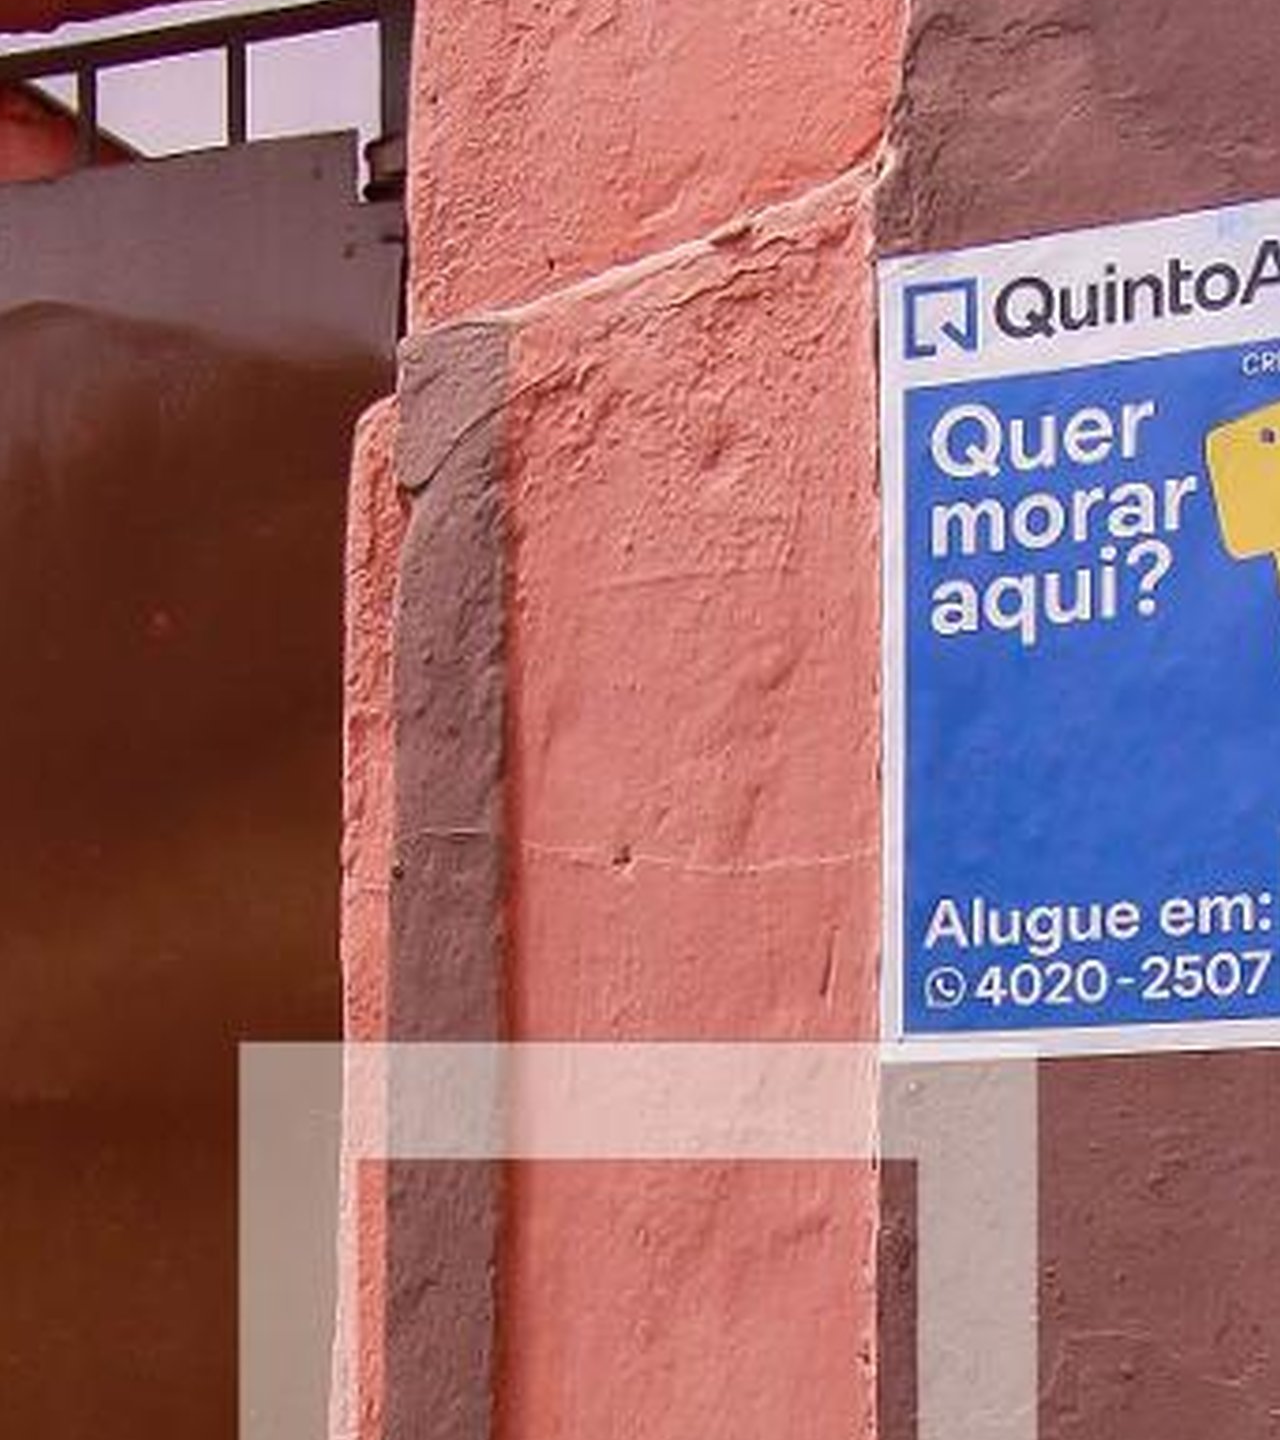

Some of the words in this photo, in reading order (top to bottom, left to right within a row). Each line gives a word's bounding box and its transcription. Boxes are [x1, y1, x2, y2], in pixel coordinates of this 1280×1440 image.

[930, 398, 1156, 478] Quer
[930, 474, 1197, 558] morar
[931, 540, 1174, 644] aqui?
[924, 898, 1140, 955] Alugue
[1160, 890, 1272, 936] em:
